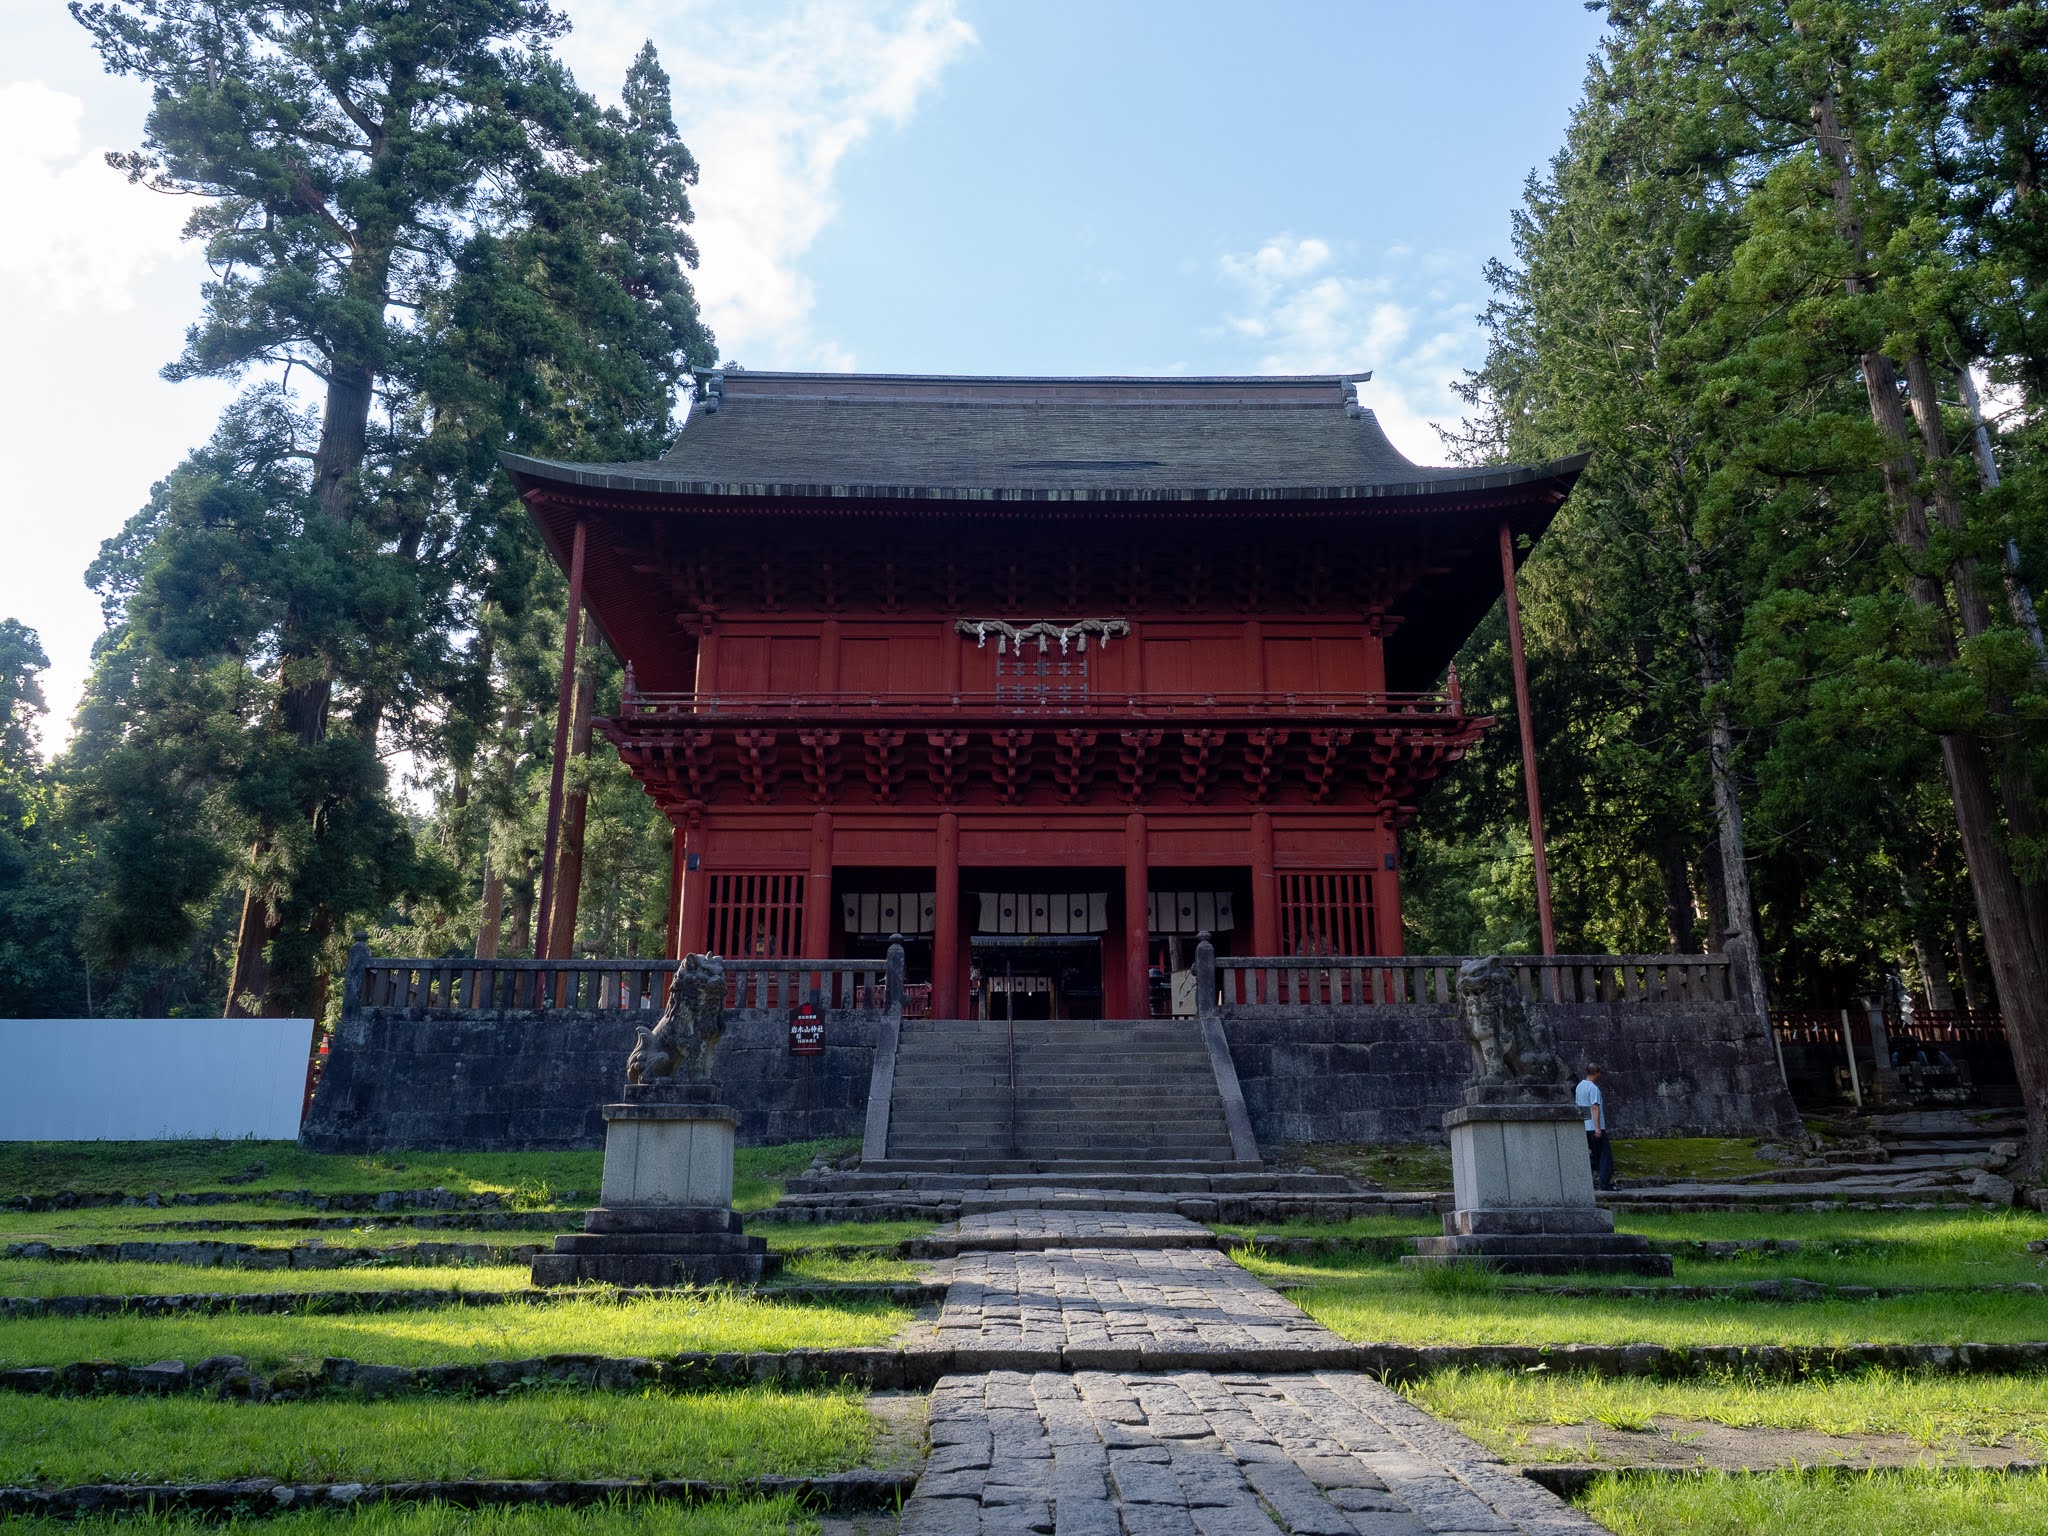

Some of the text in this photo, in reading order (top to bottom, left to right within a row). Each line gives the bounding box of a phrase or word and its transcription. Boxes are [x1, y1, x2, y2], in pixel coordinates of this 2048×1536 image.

[790, 1025, 824, 1034] 岩木山神社
